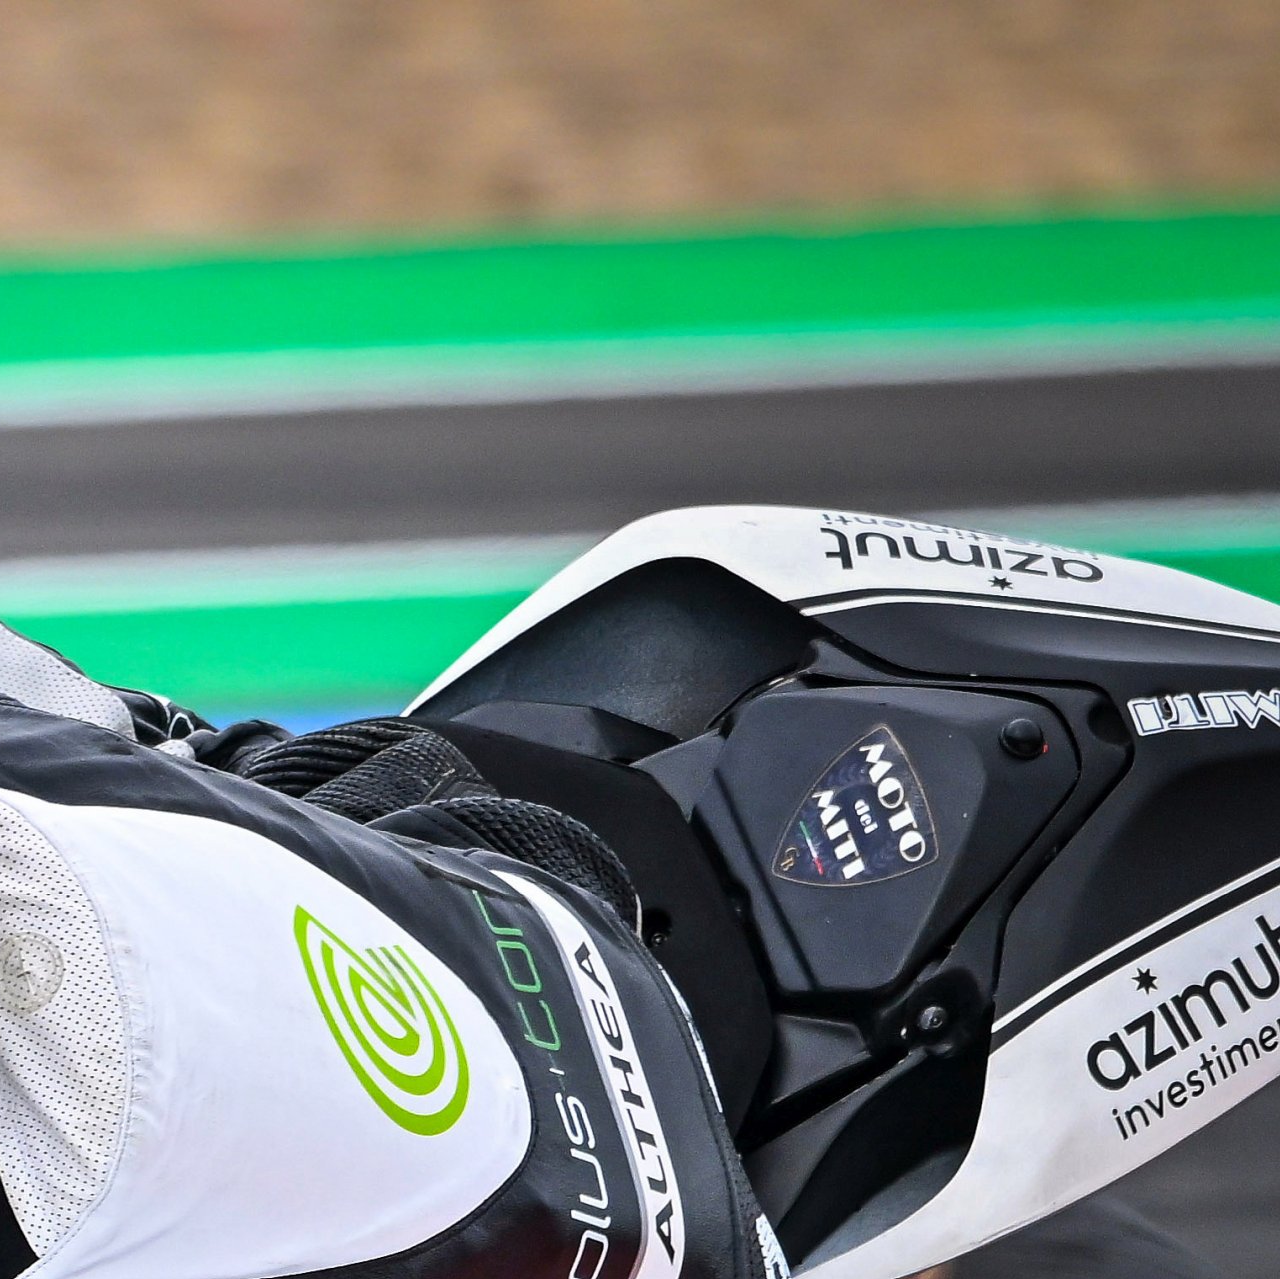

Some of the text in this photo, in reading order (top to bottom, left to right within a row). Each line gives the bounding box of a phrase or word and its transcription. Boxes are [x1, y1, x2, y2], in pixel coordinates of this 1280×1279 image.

[820, 526, 1104, 583] azimut
[812, 790, 865, 880] MITI
[859, 744, 926, 863] MOTO
[1086, 914, 1280, 1092] azimut
[573, 940, 676, 1267] ALTHEA
